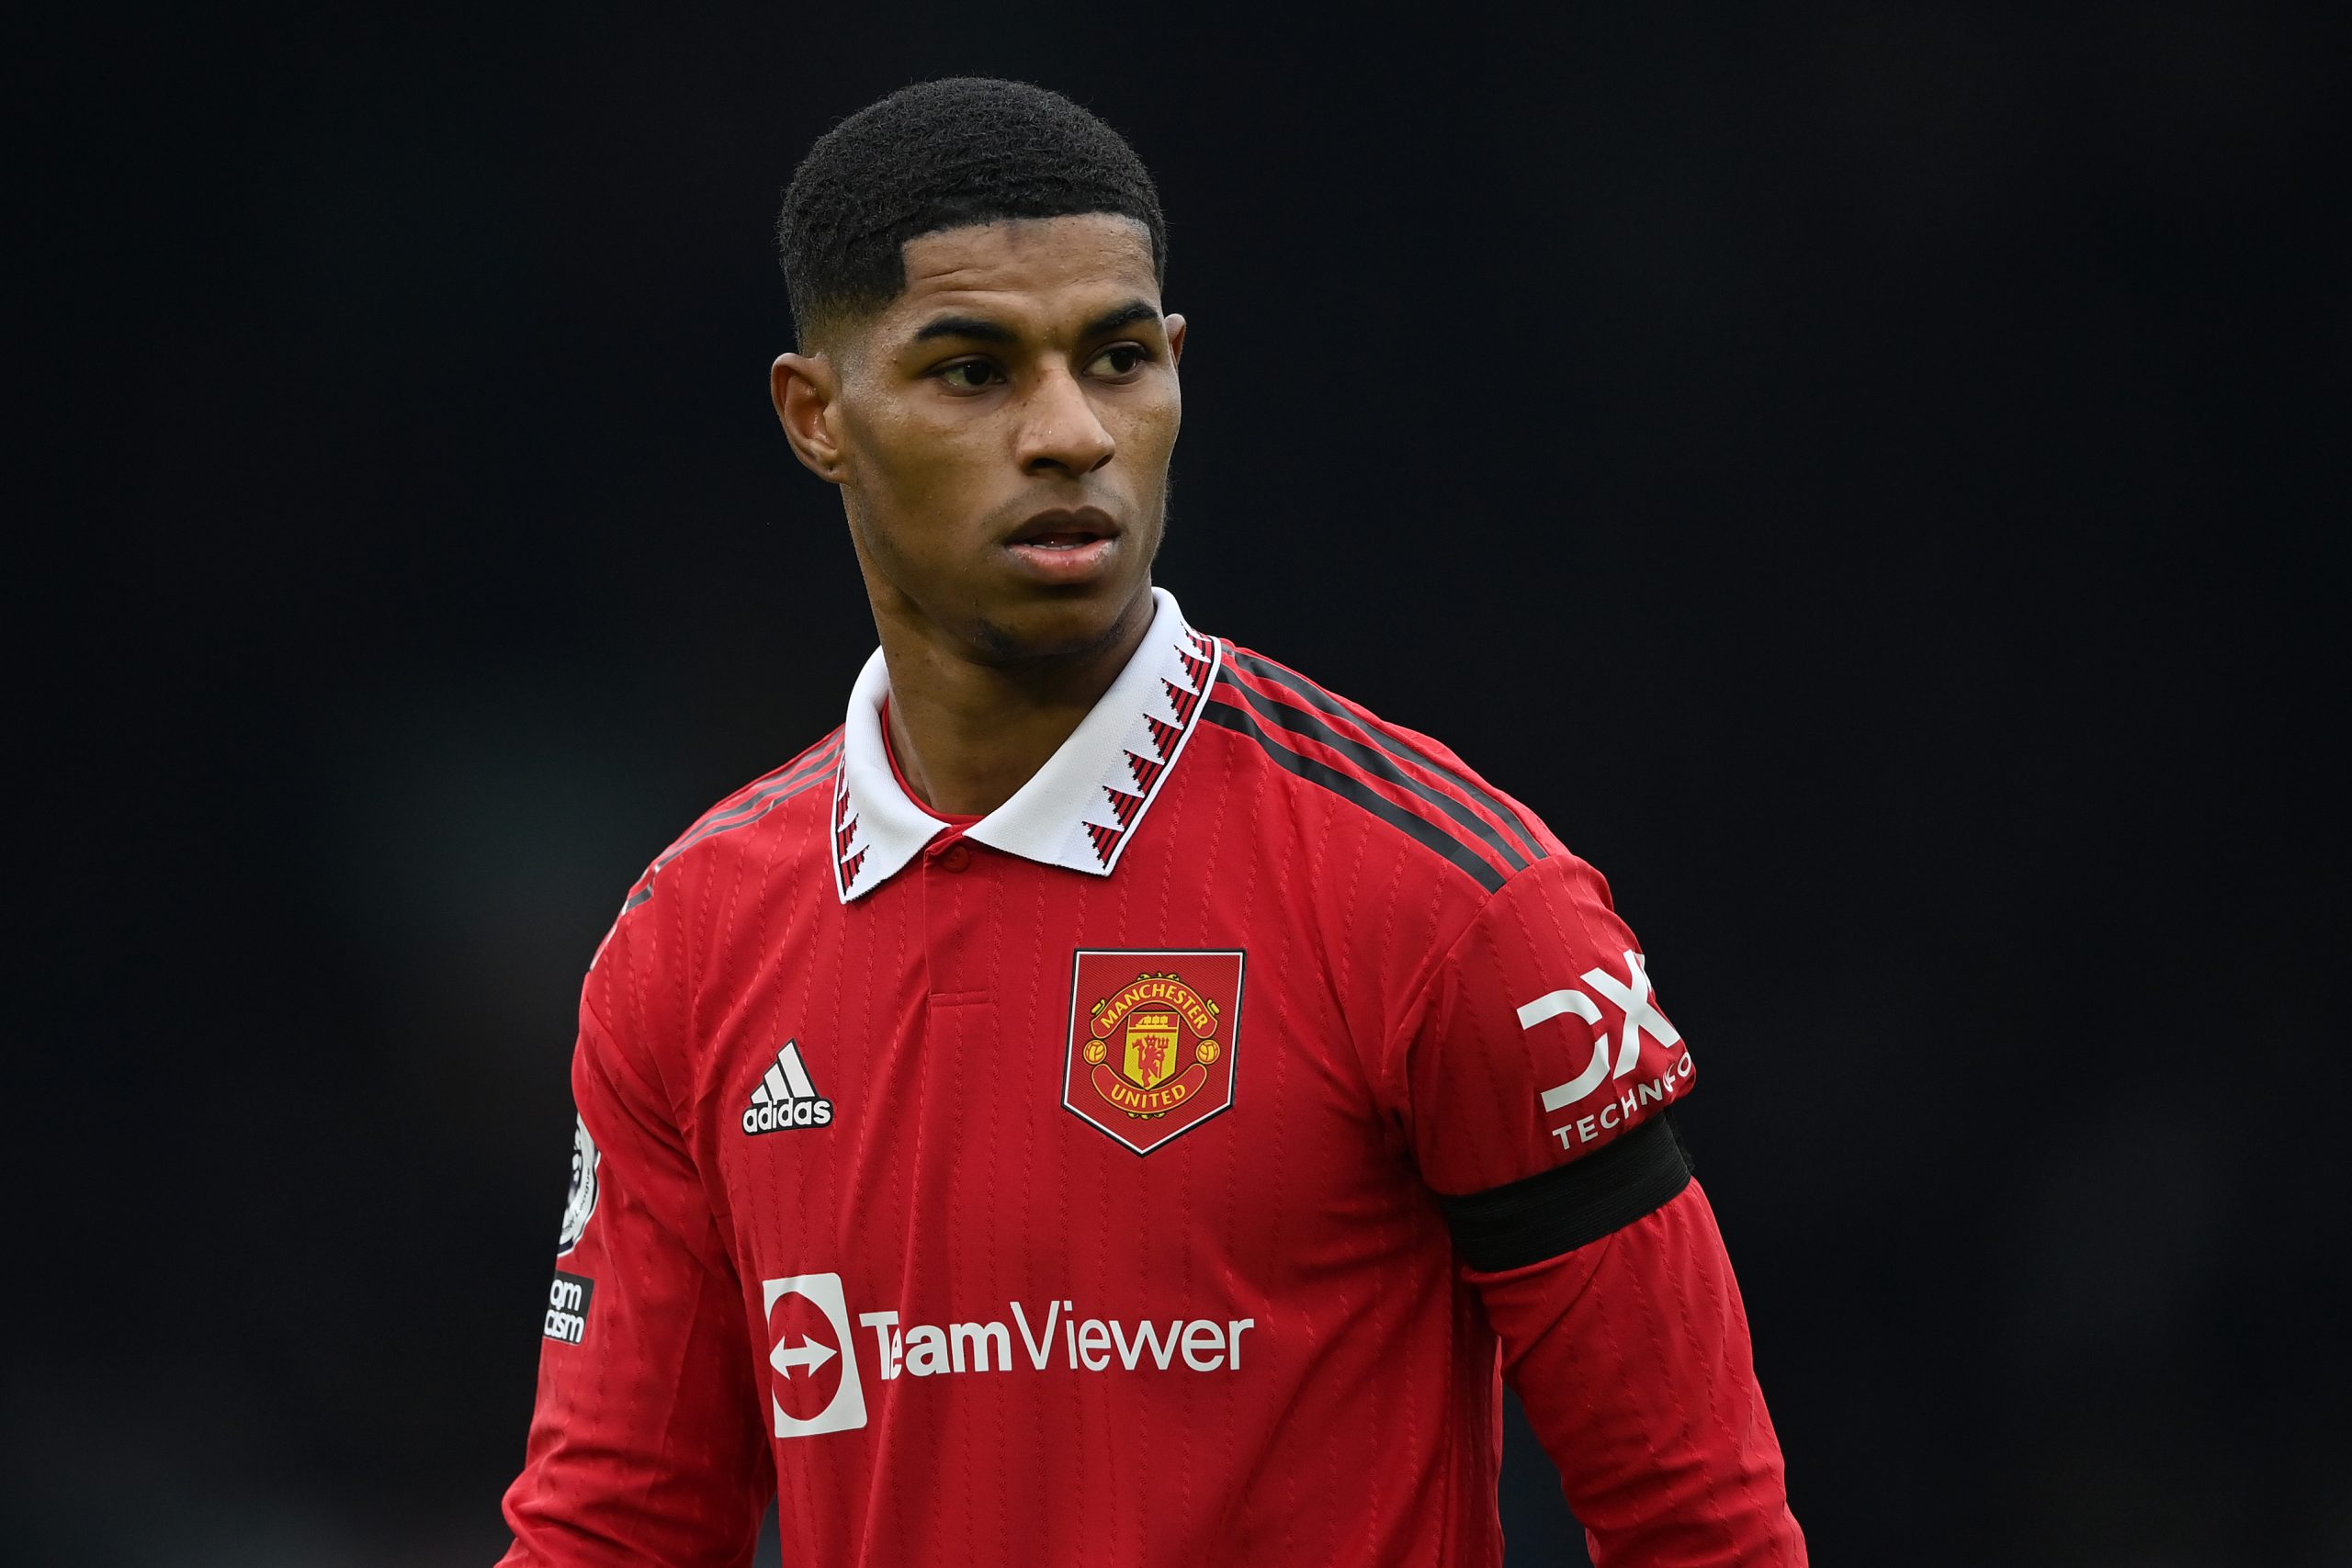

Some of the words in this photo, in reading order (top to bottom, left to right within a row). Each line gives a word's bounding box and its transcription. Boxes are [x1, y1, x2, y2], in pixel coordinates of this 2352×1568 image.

[1101, 984, 1208, 1029] MANCHESTER
[1517, 949, 1680, 1112] DX
[742, 1098, 831, 1133] adidas
[1111, 1084, 1186, 1108] UNITED
[859, 1300, 1254, 1380] TeamViewer
